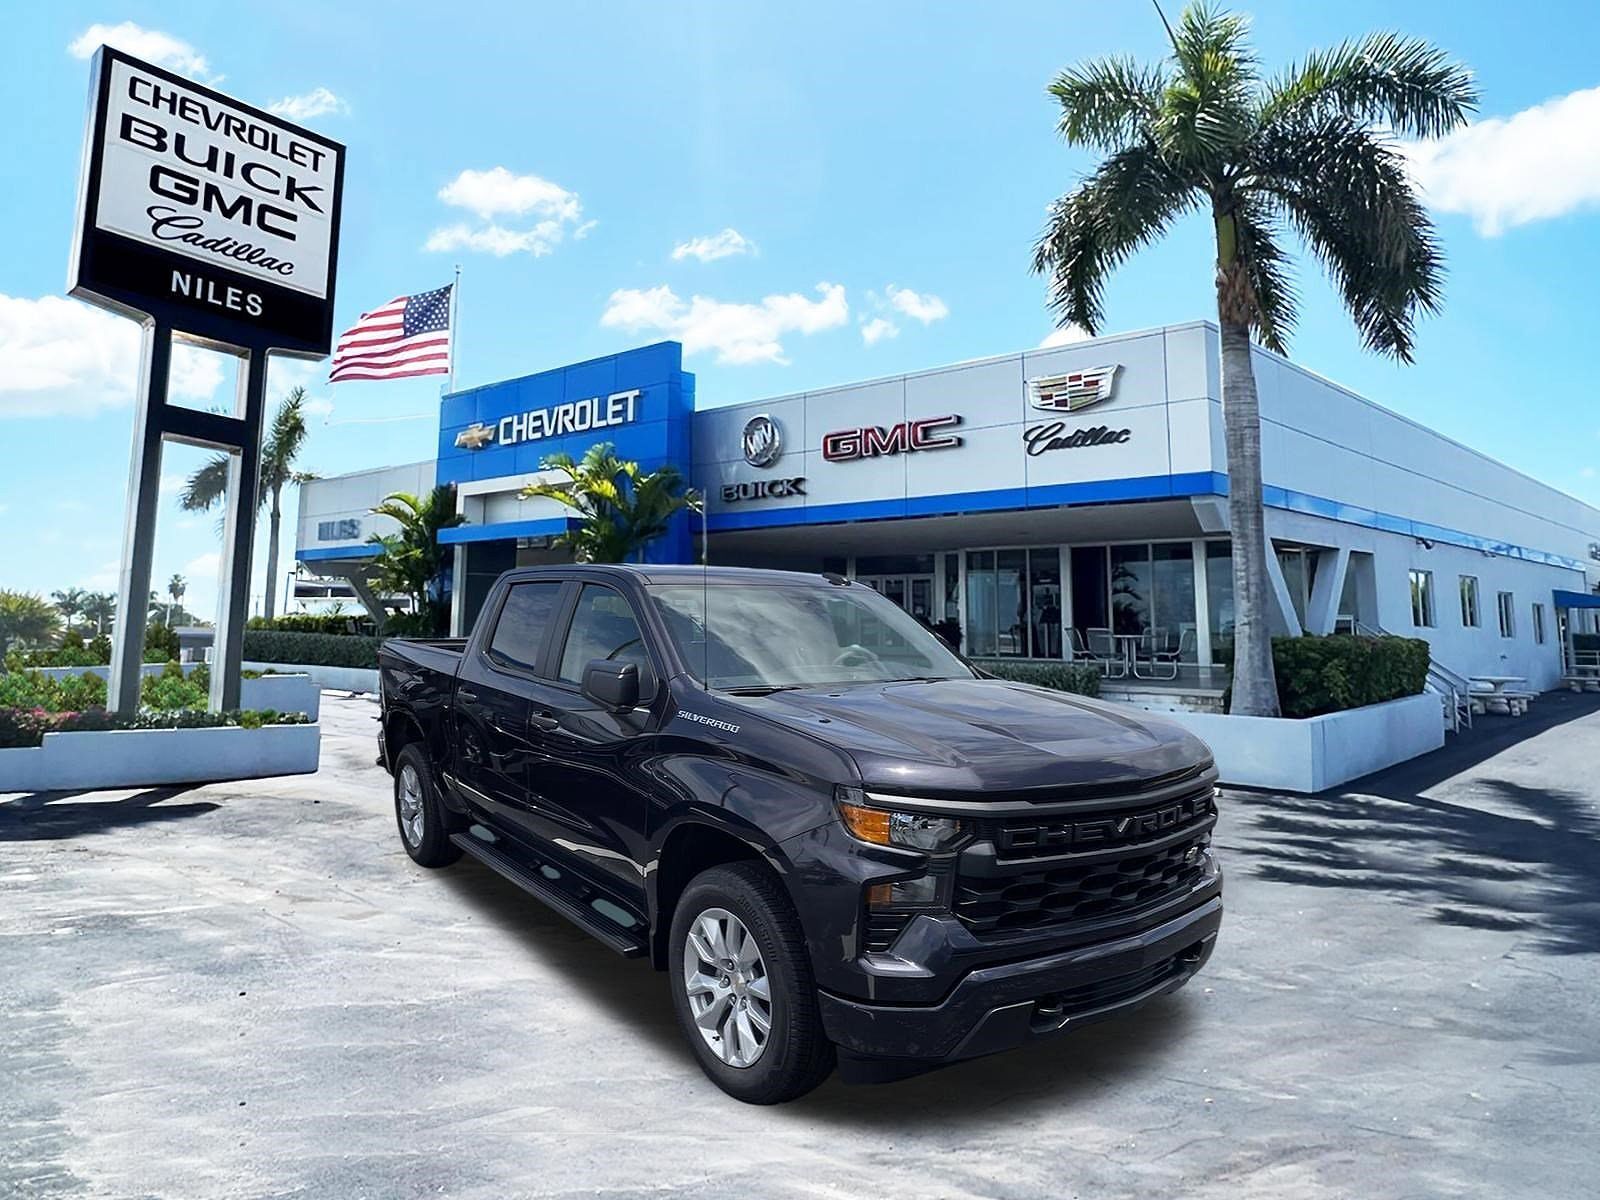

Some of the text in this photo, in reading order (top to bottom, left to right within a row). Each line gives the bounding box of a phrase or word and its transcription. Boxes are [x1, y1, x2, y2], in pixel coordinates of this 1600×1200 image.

[129, 75, 326, 172] CHEVROLET
[120, 112, 325, 214] BUICK
[150, 164, 298, 241] GMC
[146, 205, 294, 275] Cadillac
[171, 270, 263, 316] NILES
[498, 389, 641, 446] CHEVROLET
[822, 414, 961, 462] GMC
[1023, 421, 1132, 457] Cadillac
[720, 477, 808, 502] BUICK
[677, 709, 741, 734] SILVERADO
